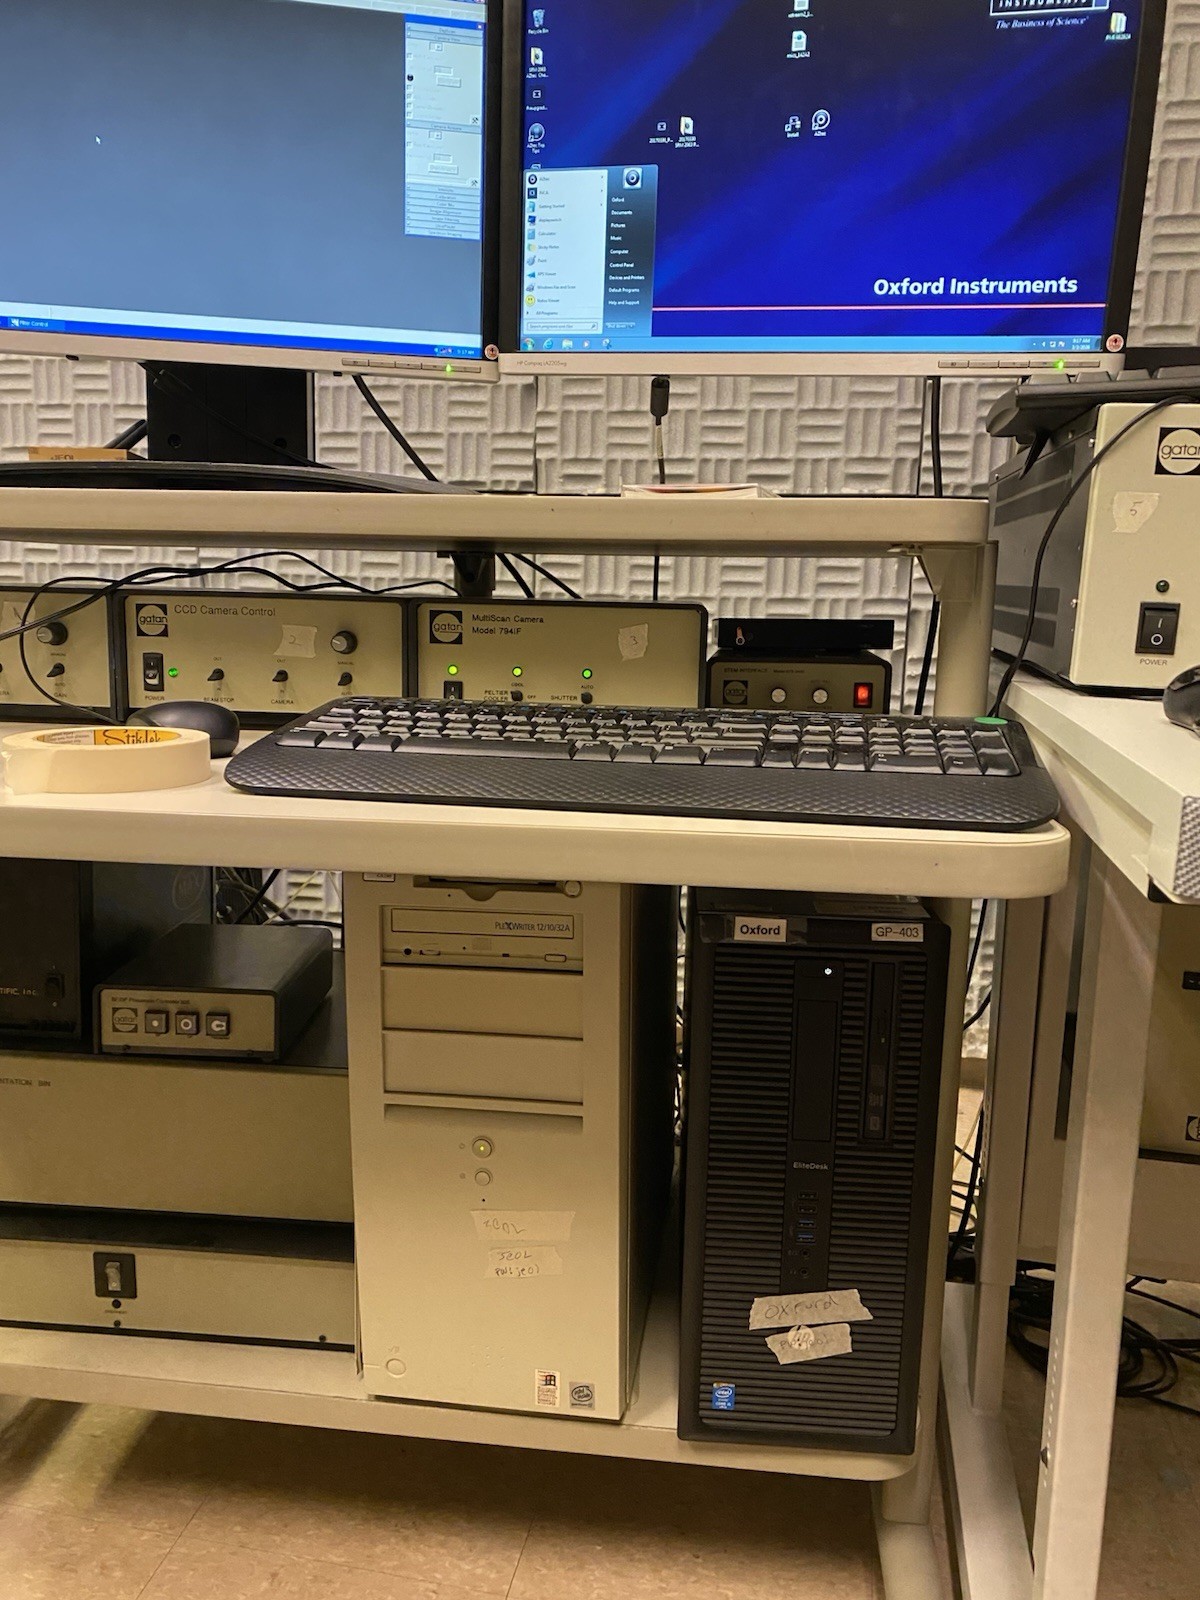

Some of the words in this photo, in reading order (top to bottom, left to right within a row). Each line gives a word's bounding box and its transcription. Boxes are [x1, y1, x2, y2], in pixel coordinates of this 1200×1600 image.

[996, 20, 1010, 29] The
[1011, 18, 1045, 28] Business
[1046, 18, 1056, 27] of
[873, 277, 945, 296] Oxford
[949, 276, 1079, 294] Instruments
[173, 604, 198, 615] CCD
[200, 605, 238, 616] Camera
[241, 606, 276, 617] Control
[139, 615, 168, 626] gatan
[471, 614, 511, 623] MultiScan
[513, 614, 545, 624] Camera
[433, 622, 463, 633] gatan
[471, 627, 496, 635] Model
[1139, 658, 1168, 666] POWER
[536, 923, 571, 933] 12/10/32A
[739, 924, 781, 936] Oxford
[875, 927, 920, 938] GP-403
[793, 1161, 829, 1170] EliteDesk
